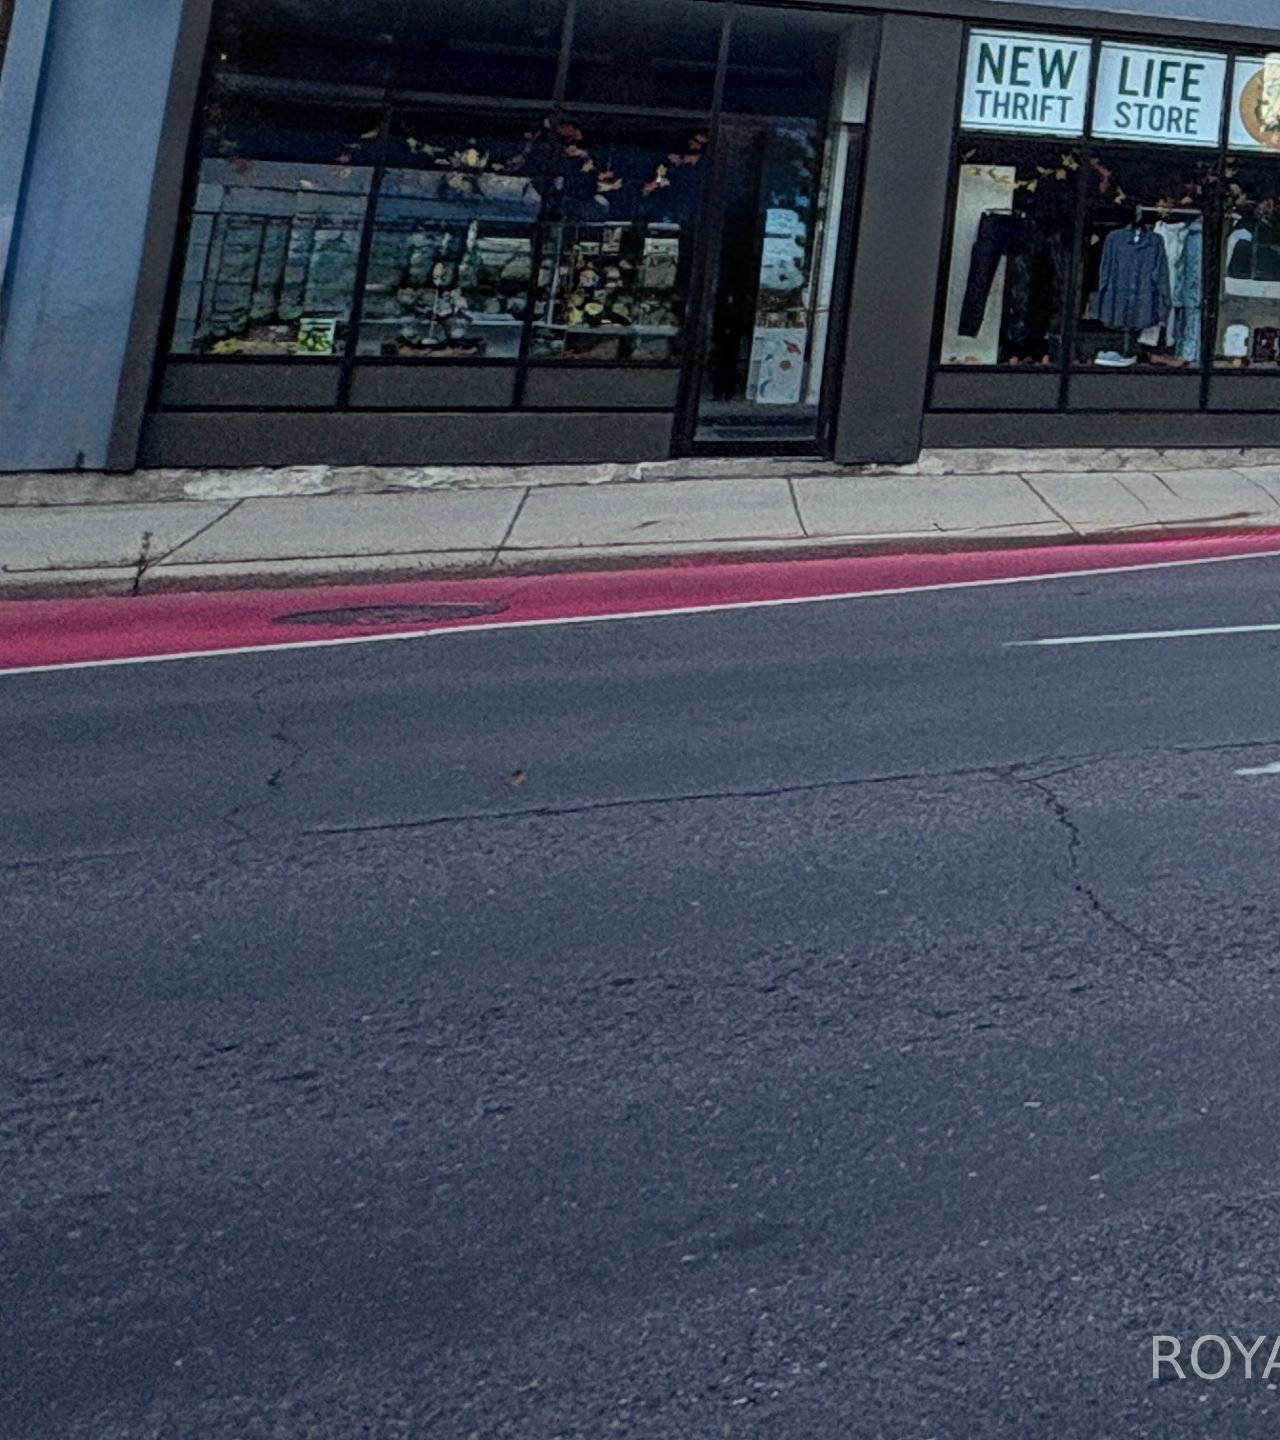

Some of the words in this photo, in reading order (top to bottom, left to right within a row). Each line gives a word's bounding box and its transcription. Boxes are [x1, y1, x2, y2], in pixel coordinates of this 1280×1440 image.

[975, 42, 1078, 90] NEW
[1117, 55, 1206, 103] LIFE
[974, 89, 1074, 123] THRIFT
[1114, 101, 1200, 135] STORE
